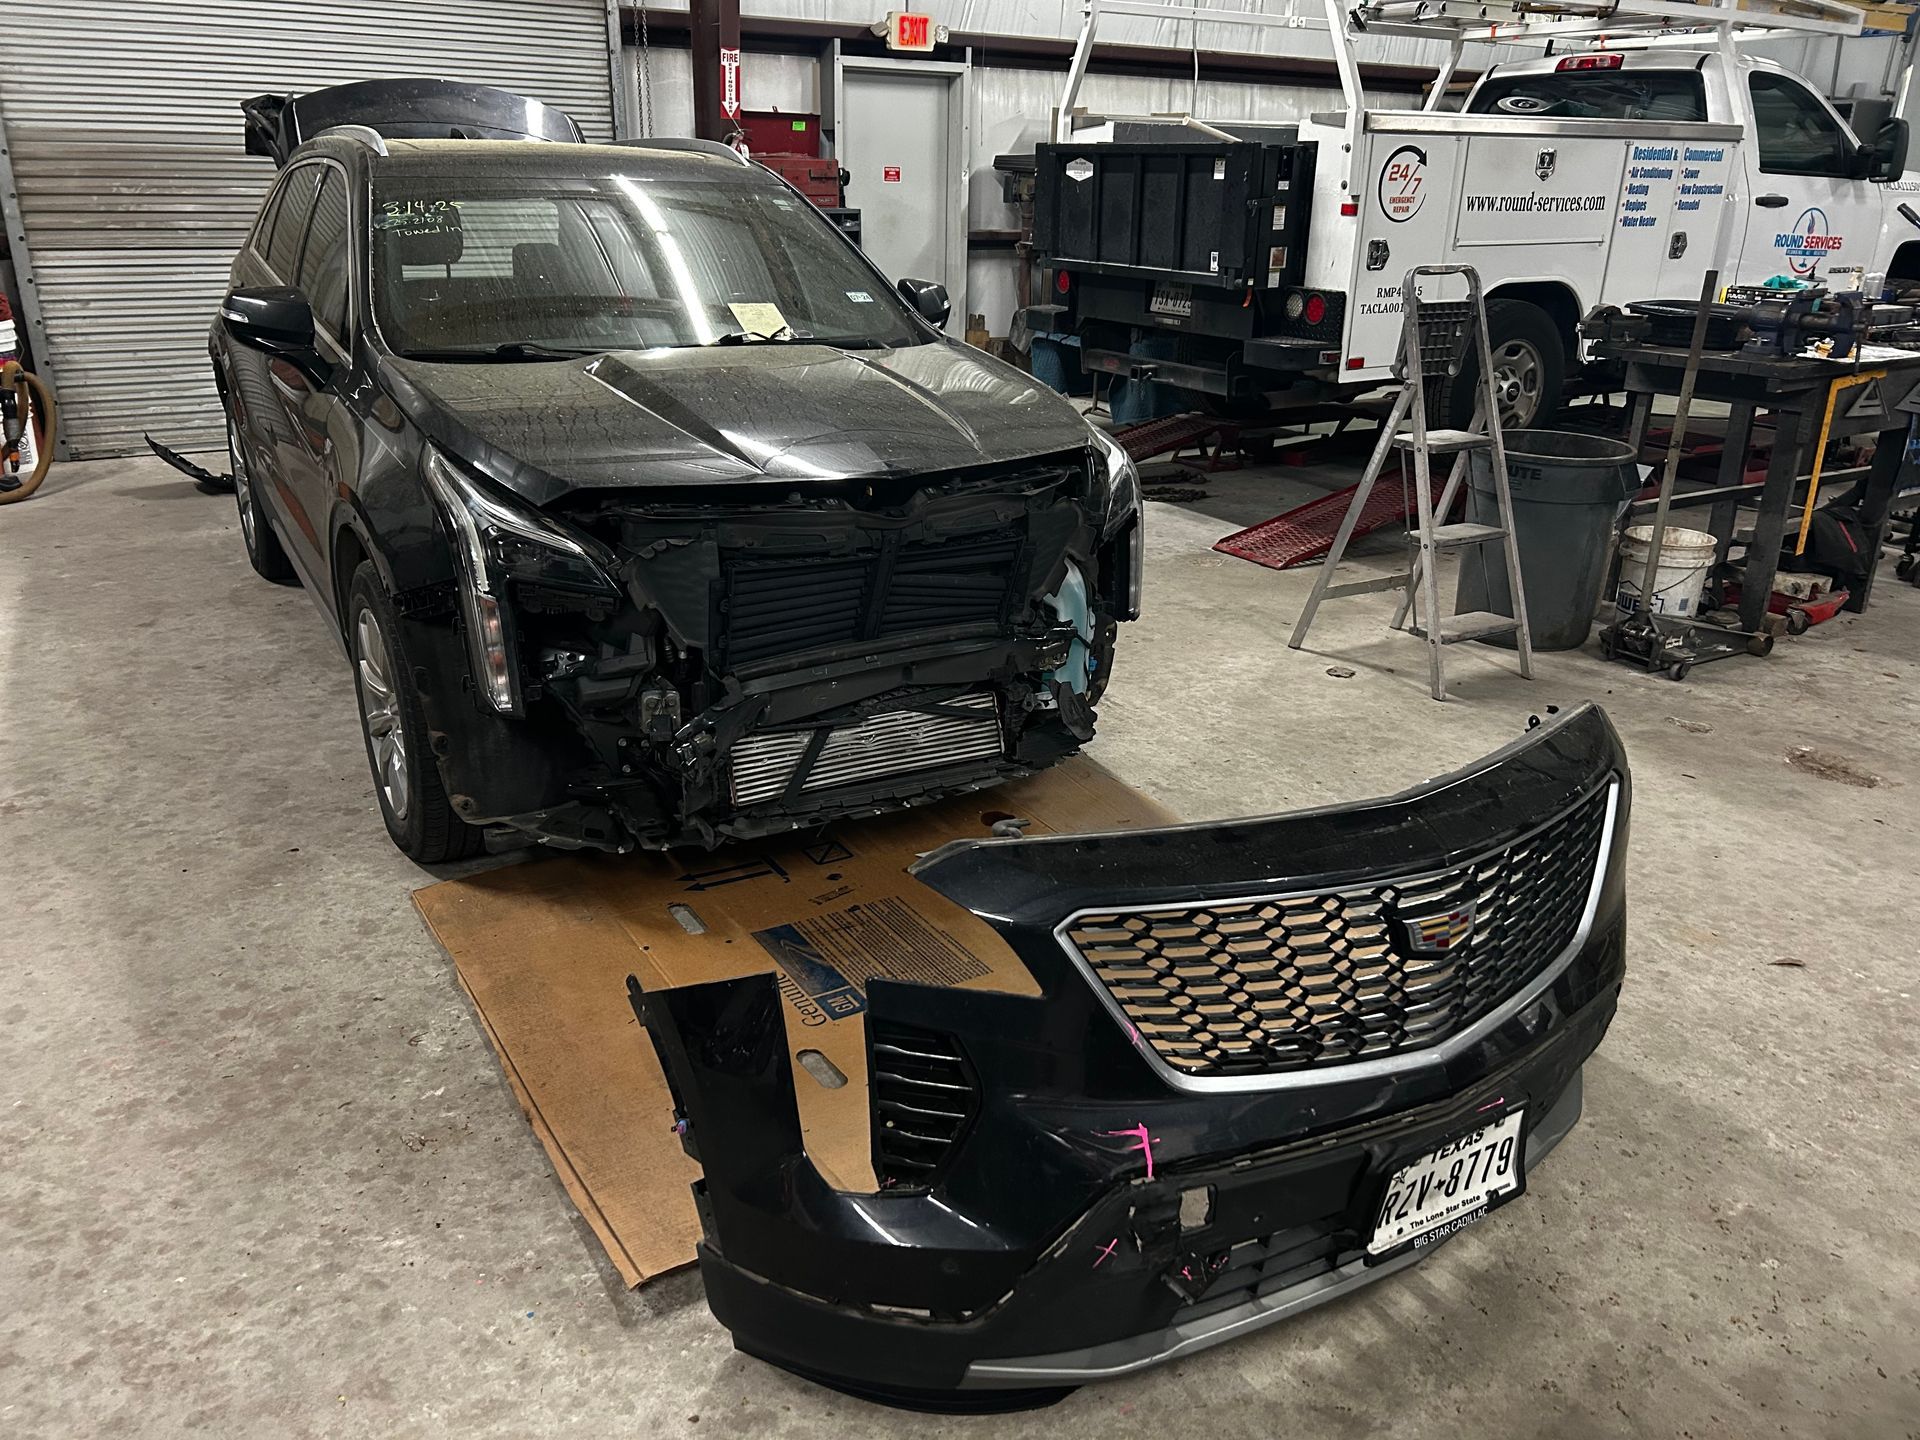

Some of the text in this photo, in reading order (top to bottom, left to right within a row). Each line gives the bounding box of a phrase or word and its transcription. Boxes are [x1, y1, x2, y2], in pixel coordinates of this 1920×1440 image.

[899, 15, 929, 47] EXIT
[722, 53, 738, 63] FIRE
[1633, 146, 1674, 161] Residential
[1684, 147, 1724, 162] Commercial
[1388, 163, 1423, 195] 24/7
[1630, 167, 1673, 180] Air Conditioning
[1683, 168, 1700, 179] Sewer
[1628, 183, 1650, 196] Heating
[1680, 184, 1724, 195] New Construction
[1389, 196, 1416, 204] EMERGENCY
[1466, 191, 1606, 212] www.round-services.com
[1624, 199, 1647, 212] Repipes
[1677, 199, 1701, 211] Remodel
[1393, 205, 1410, 213] REPAIR
[1622, 215, 1657, 227] Water Heater
[392, 225, 441, 238] Towed
[1774, 233, 1843, 250] ROUND SERVICES
[826, 994, 854, 1014] GM
[1430, 1128, 1486, 1164] TEXAS
[1409, 1194, 1482, 1230] The Lone Star State
[1413, 1205, 1489, 1249] BIG STAR CADILLAC
